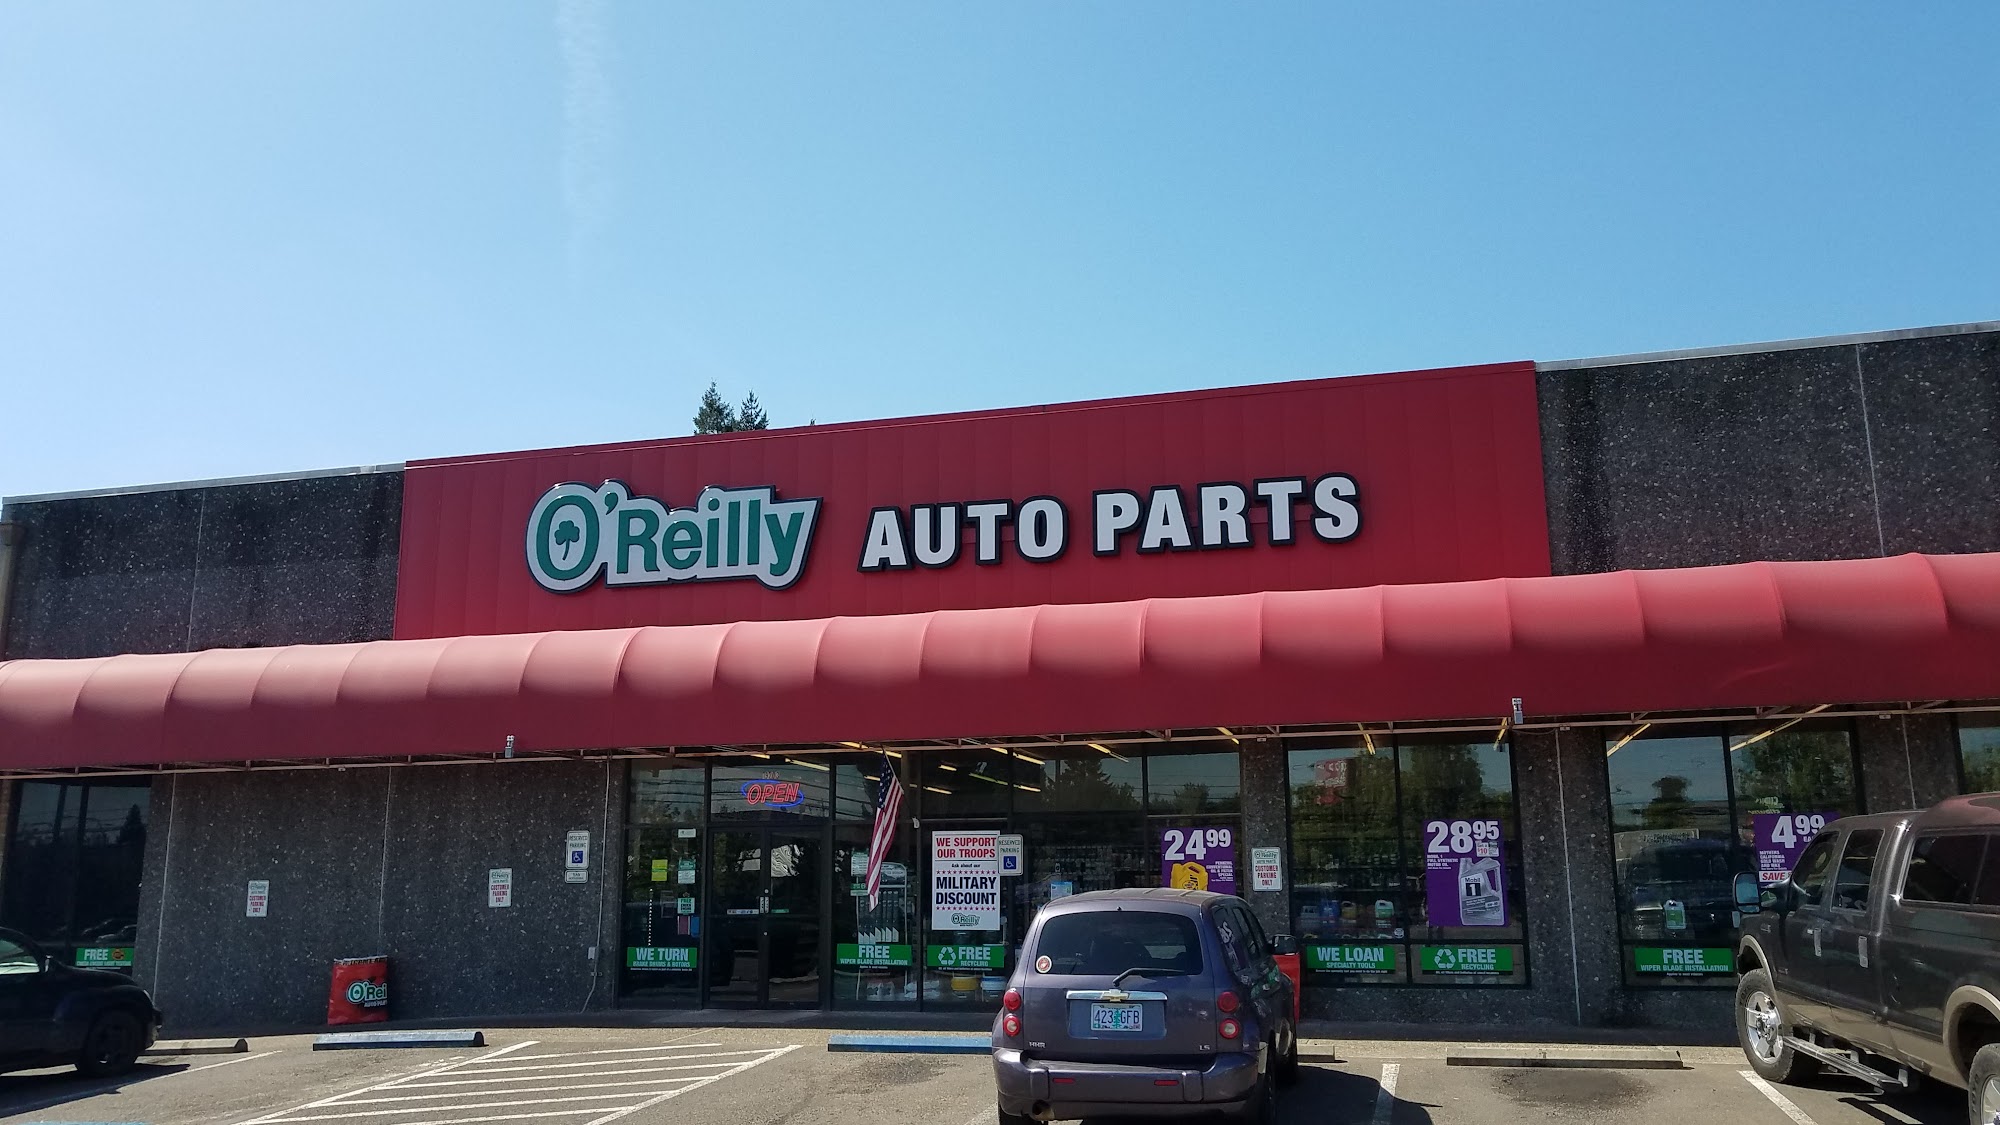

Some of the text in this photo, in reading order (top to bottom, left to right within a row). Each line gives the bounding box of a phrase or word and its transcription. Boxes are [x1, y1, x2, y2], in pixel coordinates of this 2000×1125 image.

[535, 475, 1359, 582] O'Reilly AUTO PARTS
[747, 782, 800, 805] OPEN
[936, 837, 997, 847] WE SUPPORT
[937, 848, 996, 858] OUR TROOPS
[936, 876, 997, 890] MILITARY
[1762, 872, 1786, 881] SAVE
[1469, 883, 1477, 896] 1
[935, 892, 997, 905] DISCOUNT
[952, 912, 980, 926] O'Reilly
[84, 949, 108, 961] FREE
[636, 947, 689, 961] WE TURN
[858, 945, 890, 959] FREE
[958, 946, 991, 960] FREE
[1317, 947, 1385, 962] WE LOAN
[1457, 948, 1497, 964] FREE
[1662, 949, 1705, 964] FREE
[1640, 964, 1729, 972] WIPER BLADE INSTALLATION
[1094, 1009, 1140, 1024] 423 GFB
[1028, 1041, 1046, 1049] HHR
